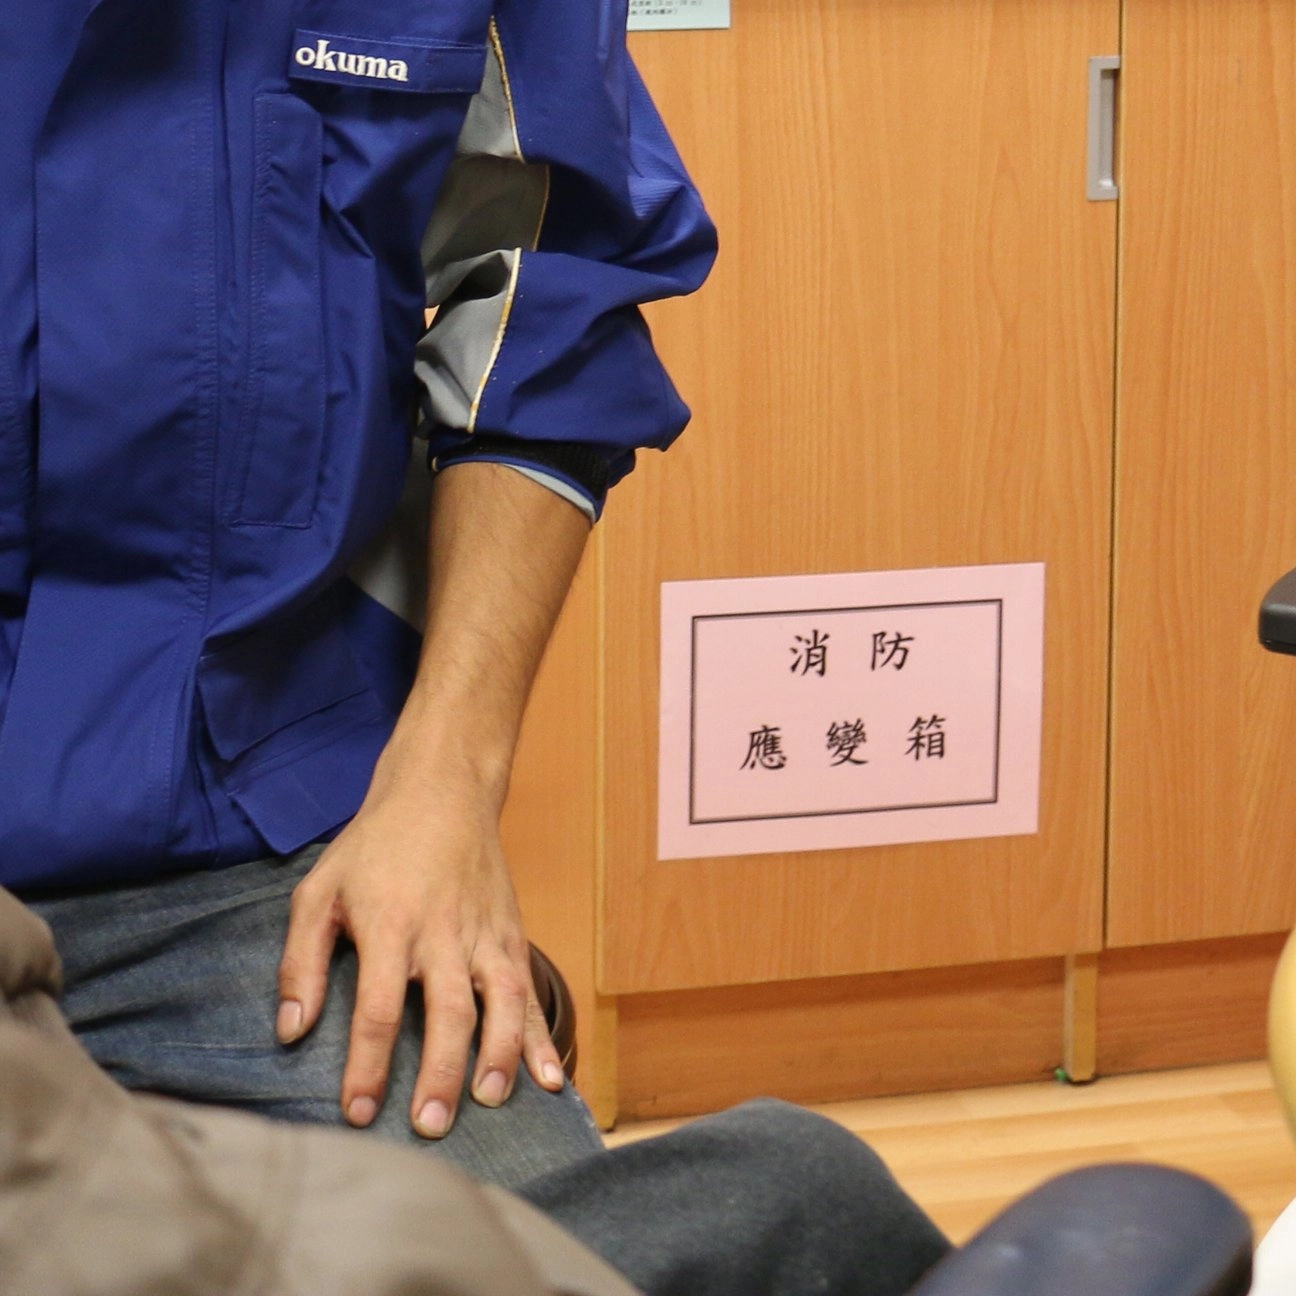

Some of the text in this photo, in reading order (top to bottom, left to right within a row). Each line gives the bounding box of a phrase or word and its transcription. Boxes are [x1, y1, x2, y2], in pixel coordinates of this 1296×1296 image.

[295, 39, 409, 82] okuma
[789, 629, 915, 677] 消防
[739, 714, 947, 771] 應變箱
